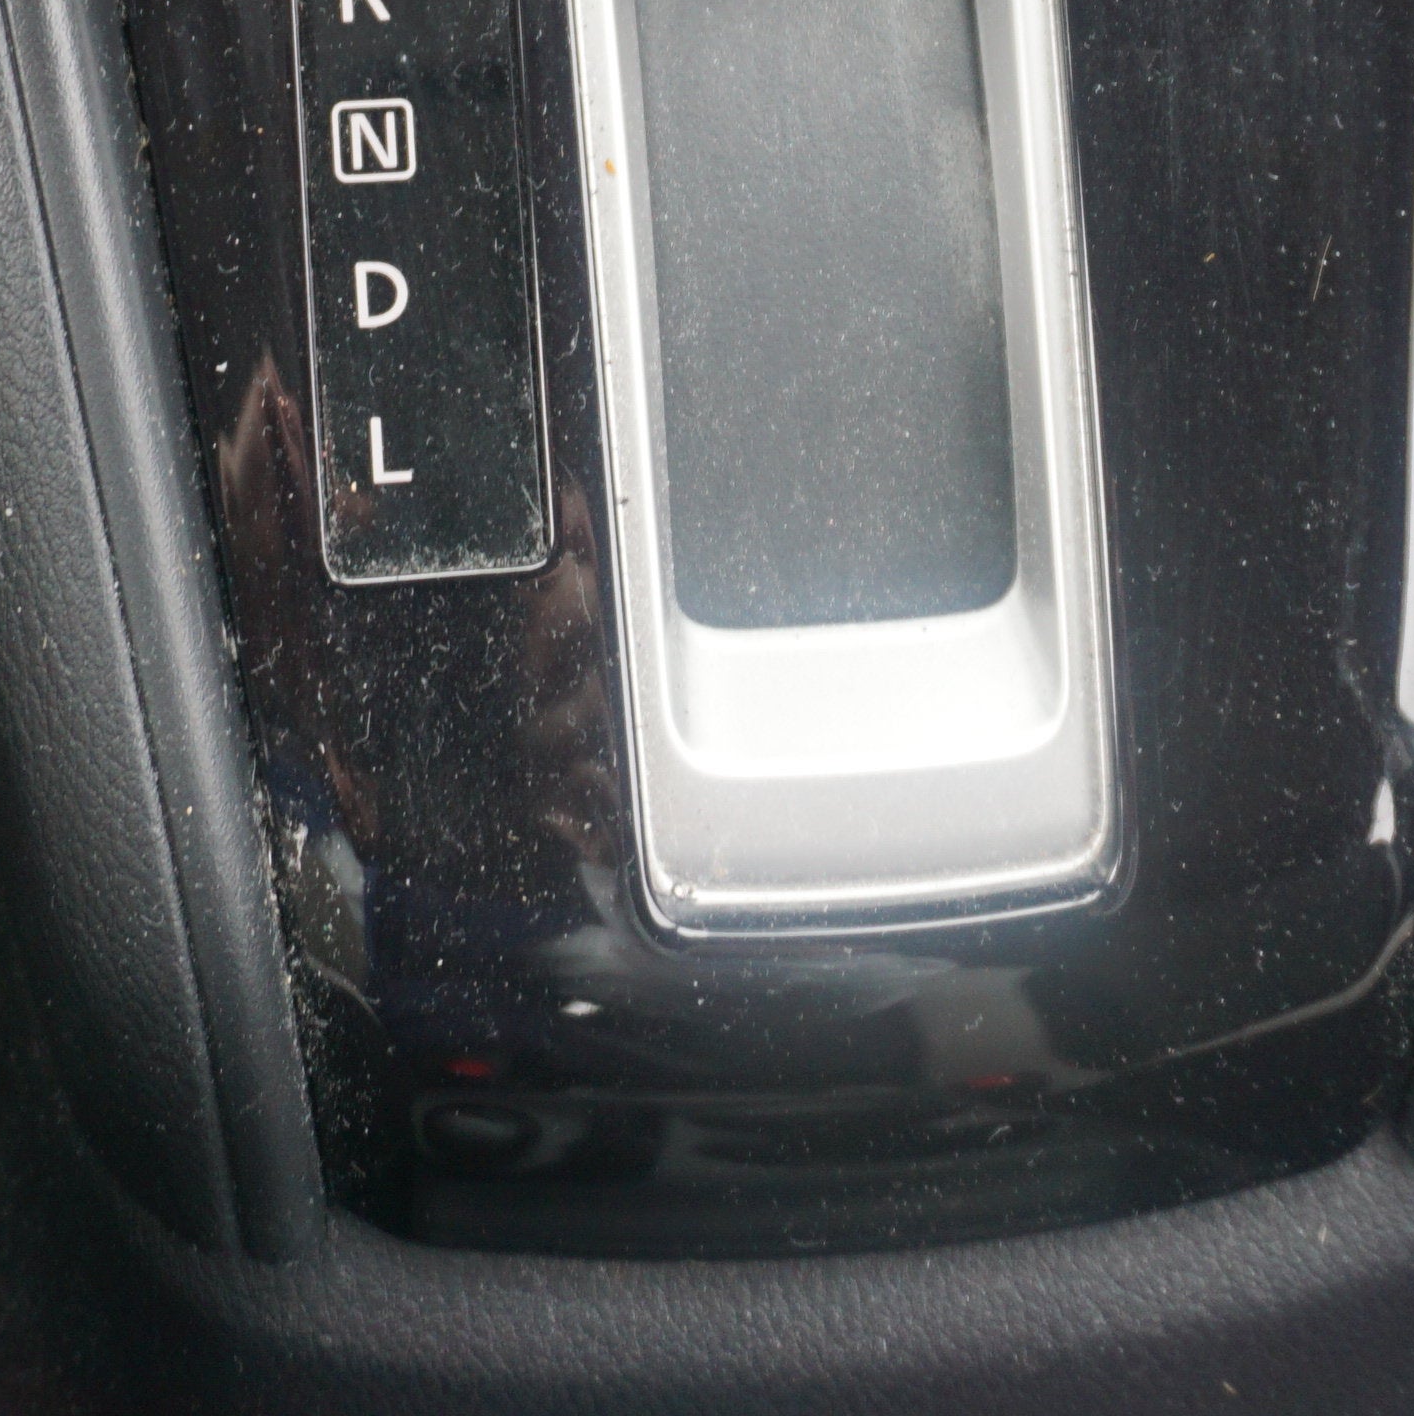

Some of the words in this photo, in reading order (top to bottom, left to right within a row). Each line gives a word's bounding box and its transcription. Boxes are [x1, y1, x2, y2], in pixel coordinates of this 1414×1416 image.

[349, 111, 398, 171] N
[354, 260, 409, 330] D
[369, 415, 414, 484] L
